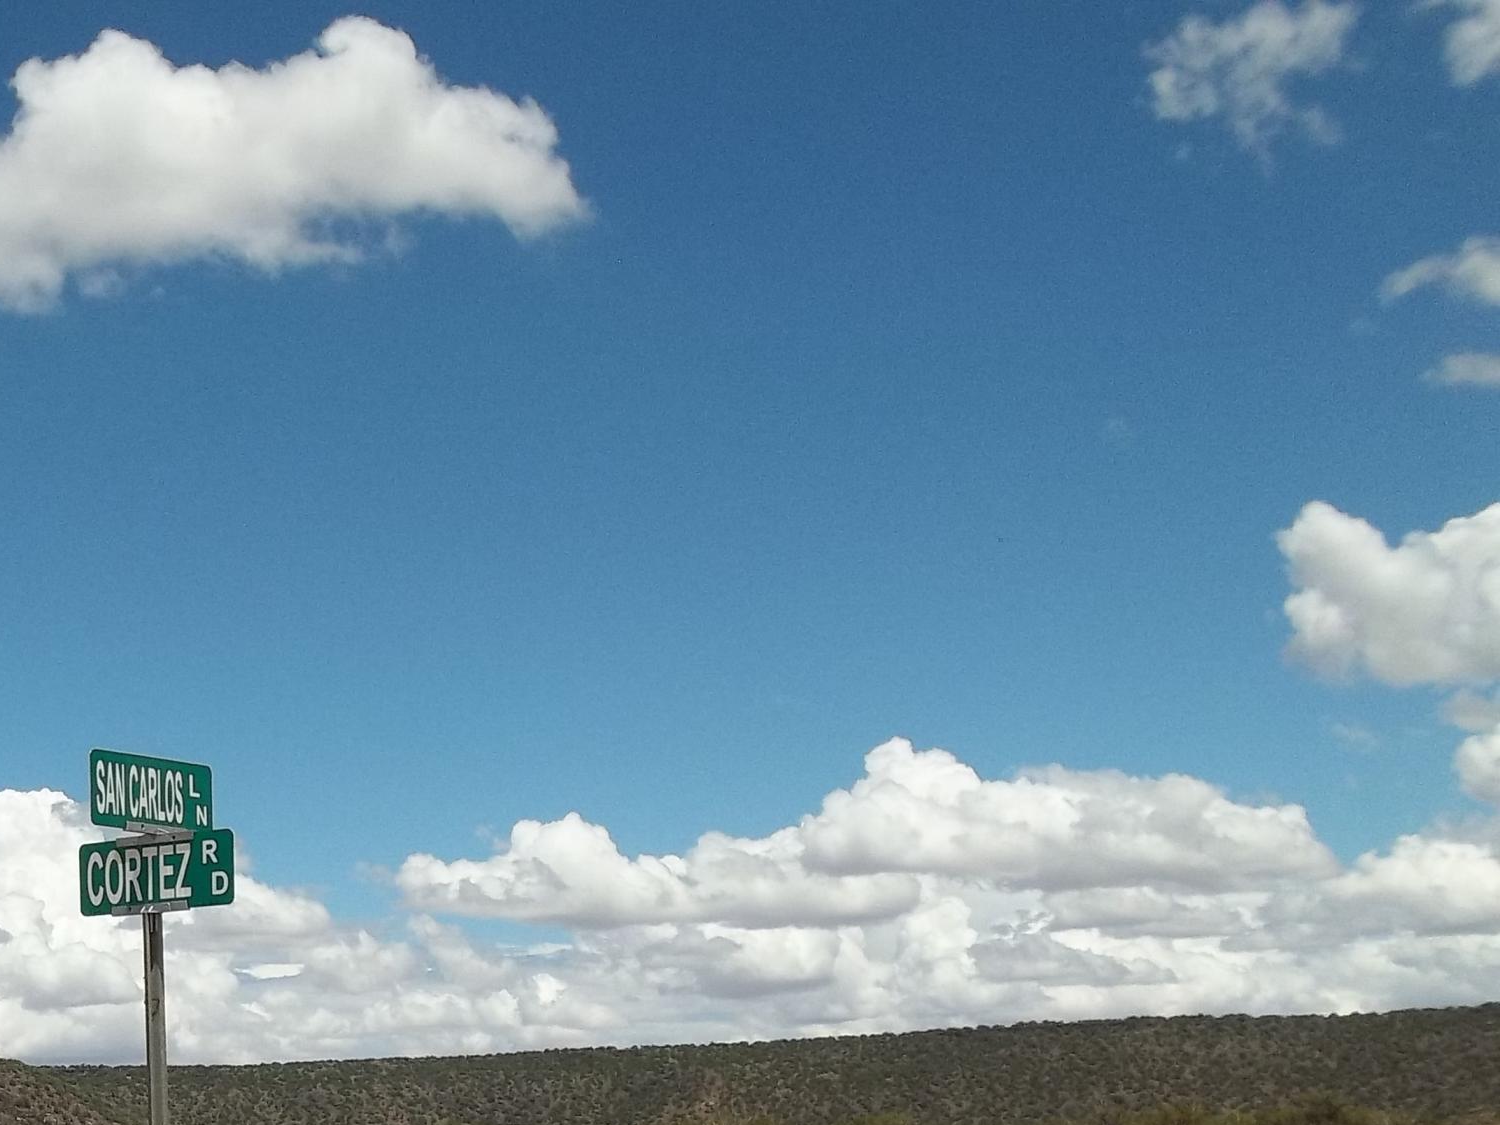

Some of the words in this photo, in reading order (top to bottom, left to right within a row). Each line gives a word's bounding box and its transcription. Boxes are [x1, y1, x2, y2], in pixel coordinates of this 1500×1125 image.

[96, 760, 126, 816] SAN
[129, 764, 184, 825] CARLOS
[87, 842, 192, 906] CORTEZ
